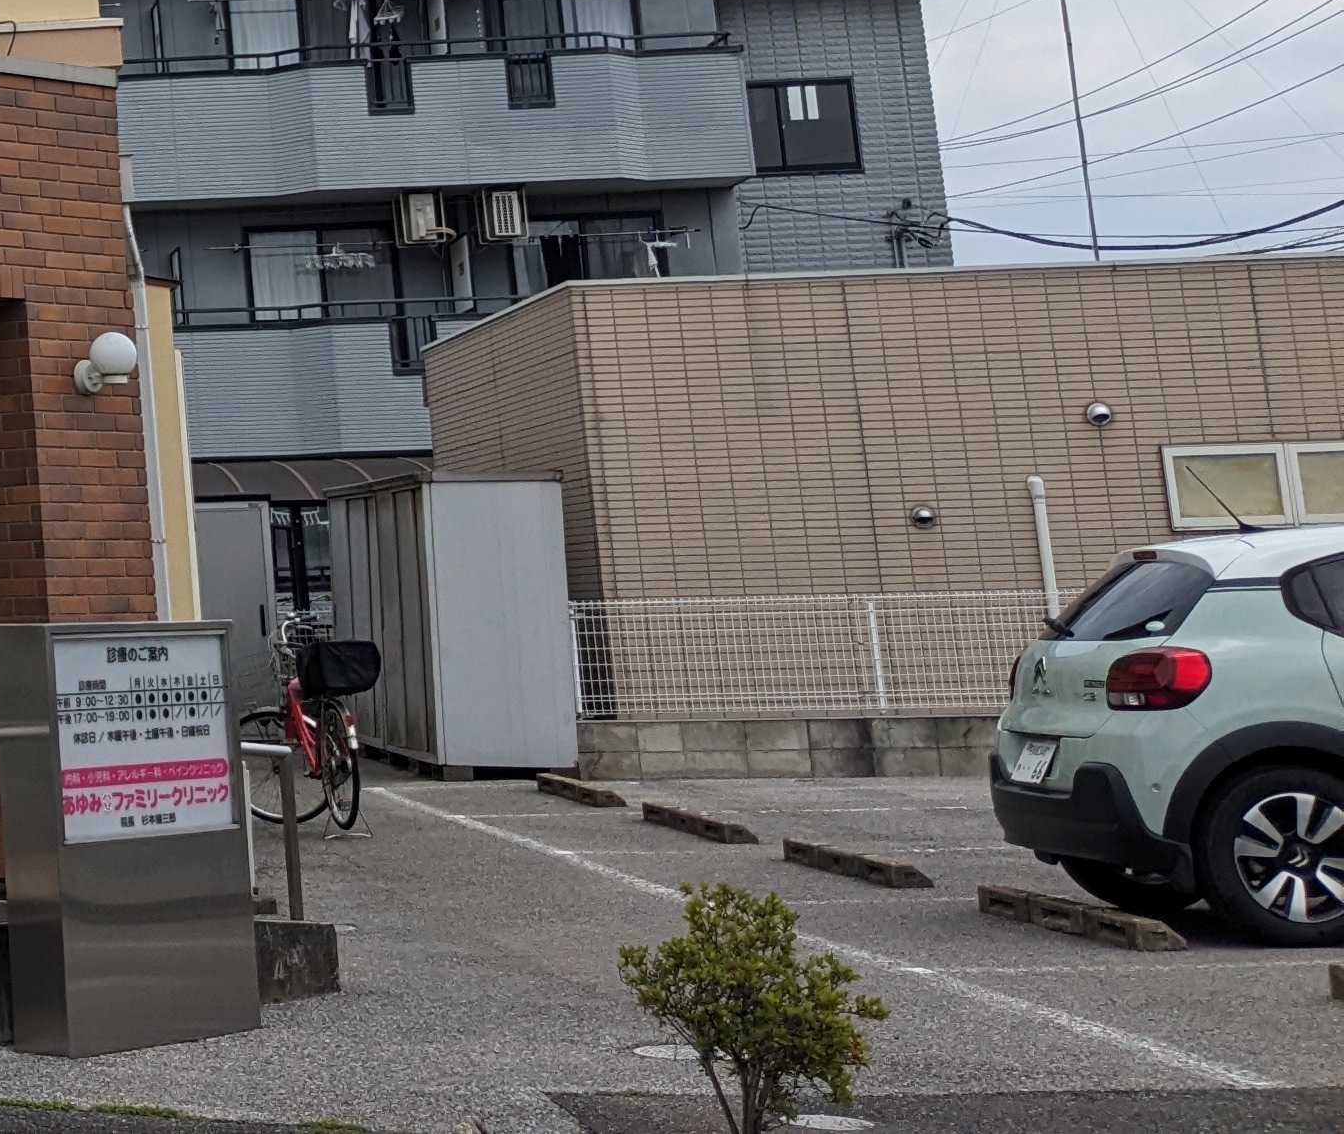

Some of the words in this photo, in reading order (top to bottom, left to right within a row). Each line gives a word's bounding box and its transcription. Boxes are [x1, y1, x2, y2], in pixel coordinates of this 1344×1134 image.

[106, 646, 169, 663] 診療のご案内
[134, 677, 141, 688] 月
[147, 677, 155, 688] 火
[160, 677, 168, 687] 水
[173, 676, 181, 686] 木
[186, 675, 194, 686] 金
[199, 675, 207, 685] 土
[212, 674, 220, 685] 日
